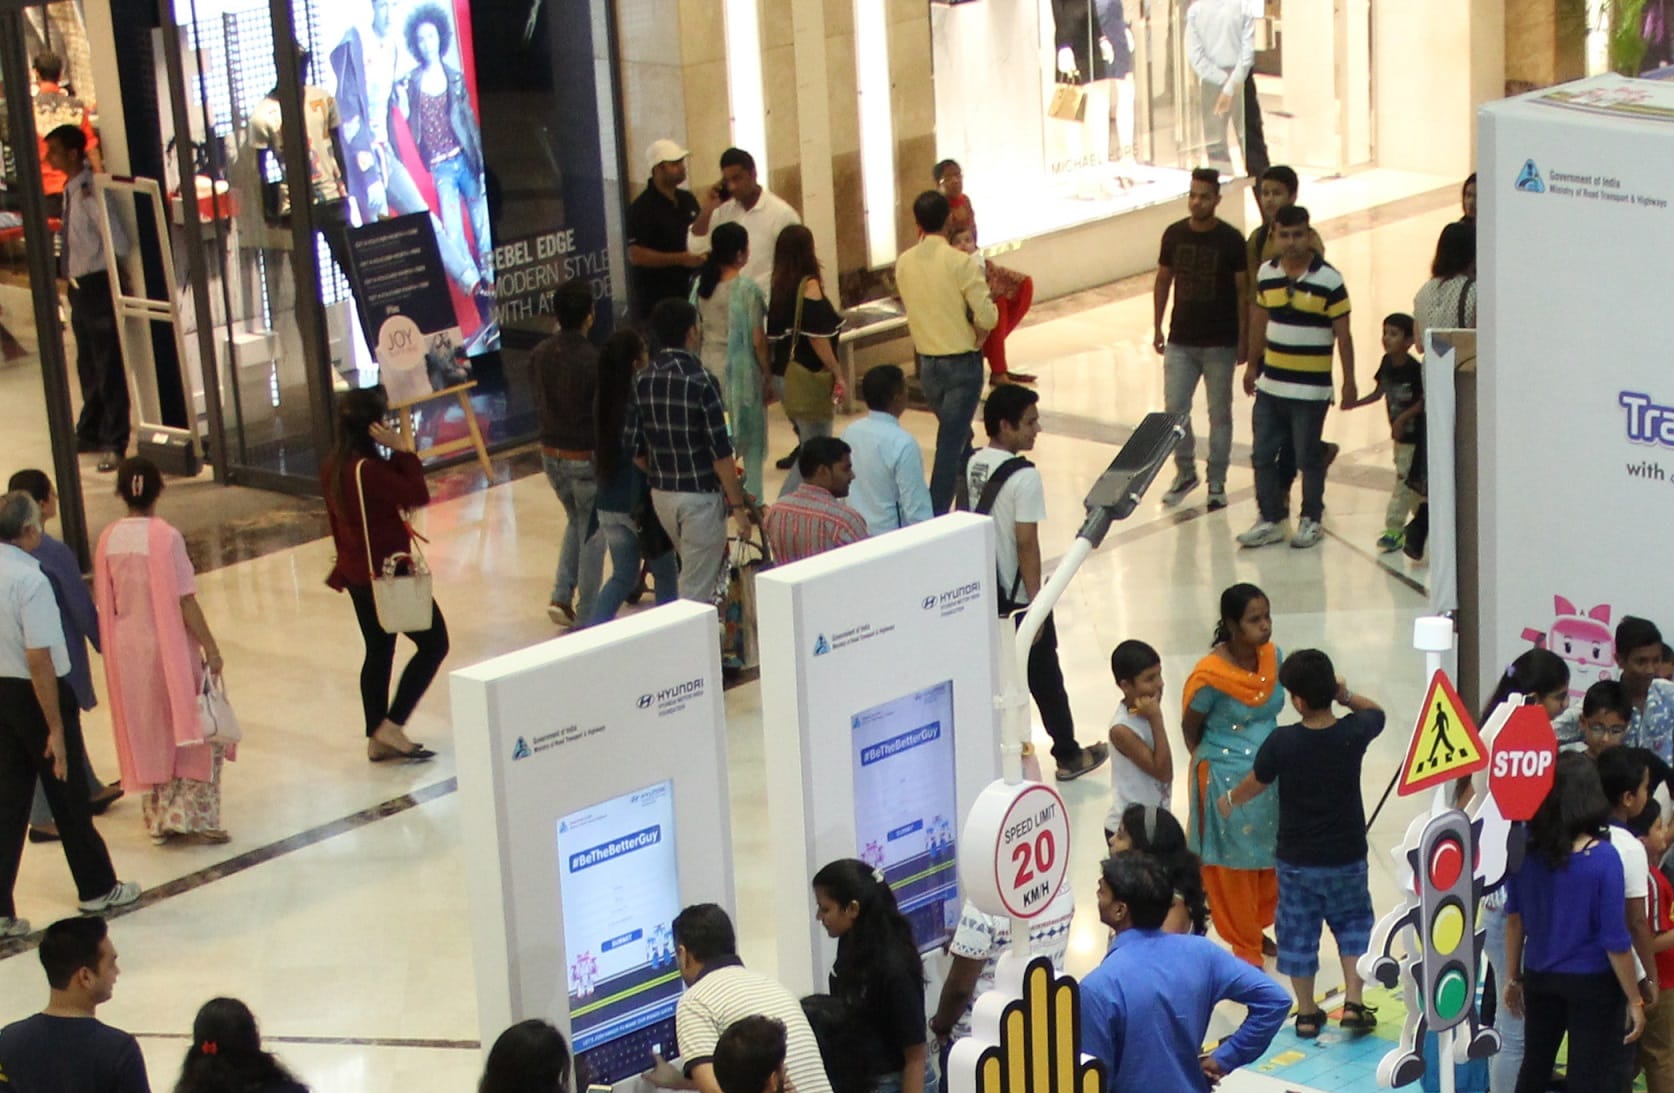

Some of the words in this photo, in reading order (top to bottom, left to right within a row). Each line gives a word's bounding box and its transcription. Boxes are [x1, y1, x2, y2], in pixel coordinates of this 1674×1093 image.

[1550, 170, 1592, 185] Government
[1602, 177, 1621, 188] India
[1549, 185, 1574, 198] Ministry
[1583, 189, 1599, 200] Road
[1600, 191, 1629, 204] Transport
[1637, 195, 1668, 208] Highways
[536, 228, 576, 256] EDGE
[388, 329, 412, 351] JOY
[1626, 461, 1665, 481] with
[939, 581, 981, 603] HYUNDAI
[657, 678, 704, 701] HYUNDAI
[864, 727, 938, 763] #BeTheBetterGuy
[1493, 750, 1552, 778] STOP
[1005, 817, 1033, 844] SPEED
[1034, 803, 1056, 828] LIMIT
[572, 830, 659, 869] #BeTheBetterGuy
[1012, 829, 1055, 890] 20
[1023, 881, 1049, 908] KM/H
